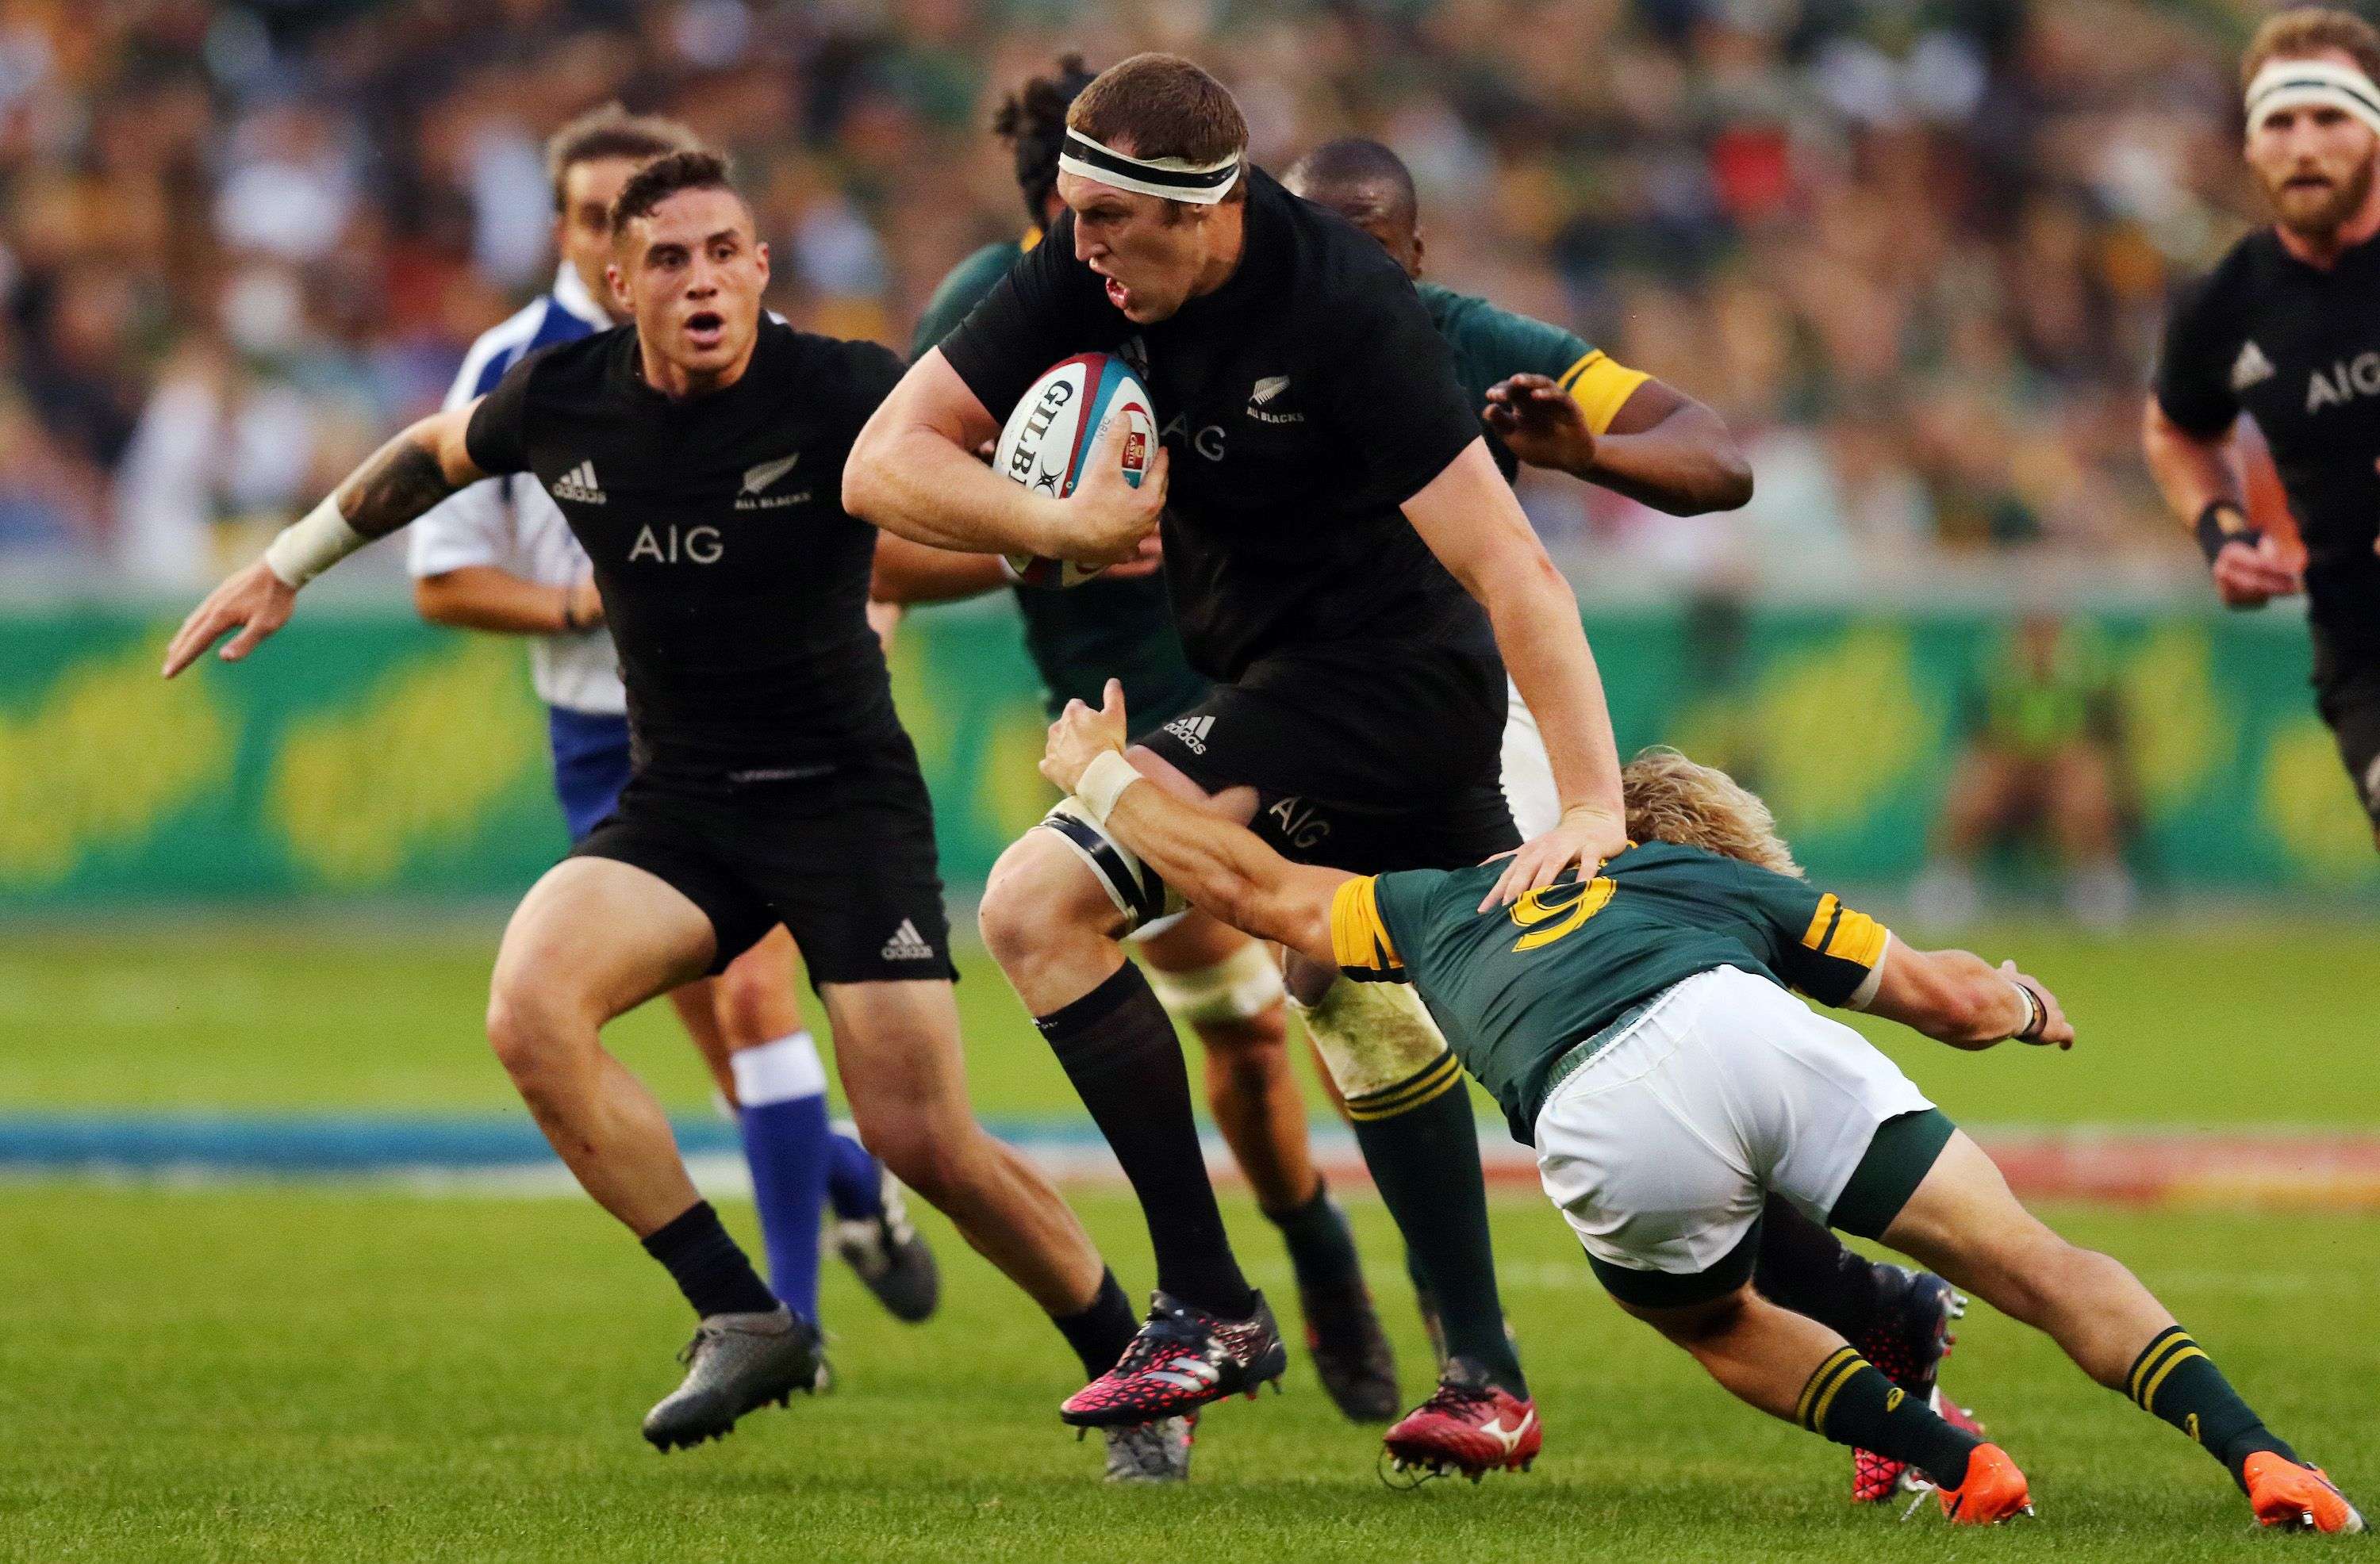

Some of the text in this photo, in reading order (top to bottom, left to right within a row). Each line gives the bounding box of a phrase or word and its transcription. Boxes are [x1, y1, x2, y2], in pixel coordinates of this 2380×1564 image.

[2307, 351, 2380, 415] AIG
[1008, 380, 1073, 486] GILB
[1246, 406, 1305, 424] ALL BLACKS
[552, 482, 607, 504] adidas
[628, 523, 724, 564] AIG
[1163, 723, 1207, 755] adidas
[1269, 796, 1331, 848] AIG
[1509, 868, 1618, 953] 9
[881, 944, 935, 961] adidas
